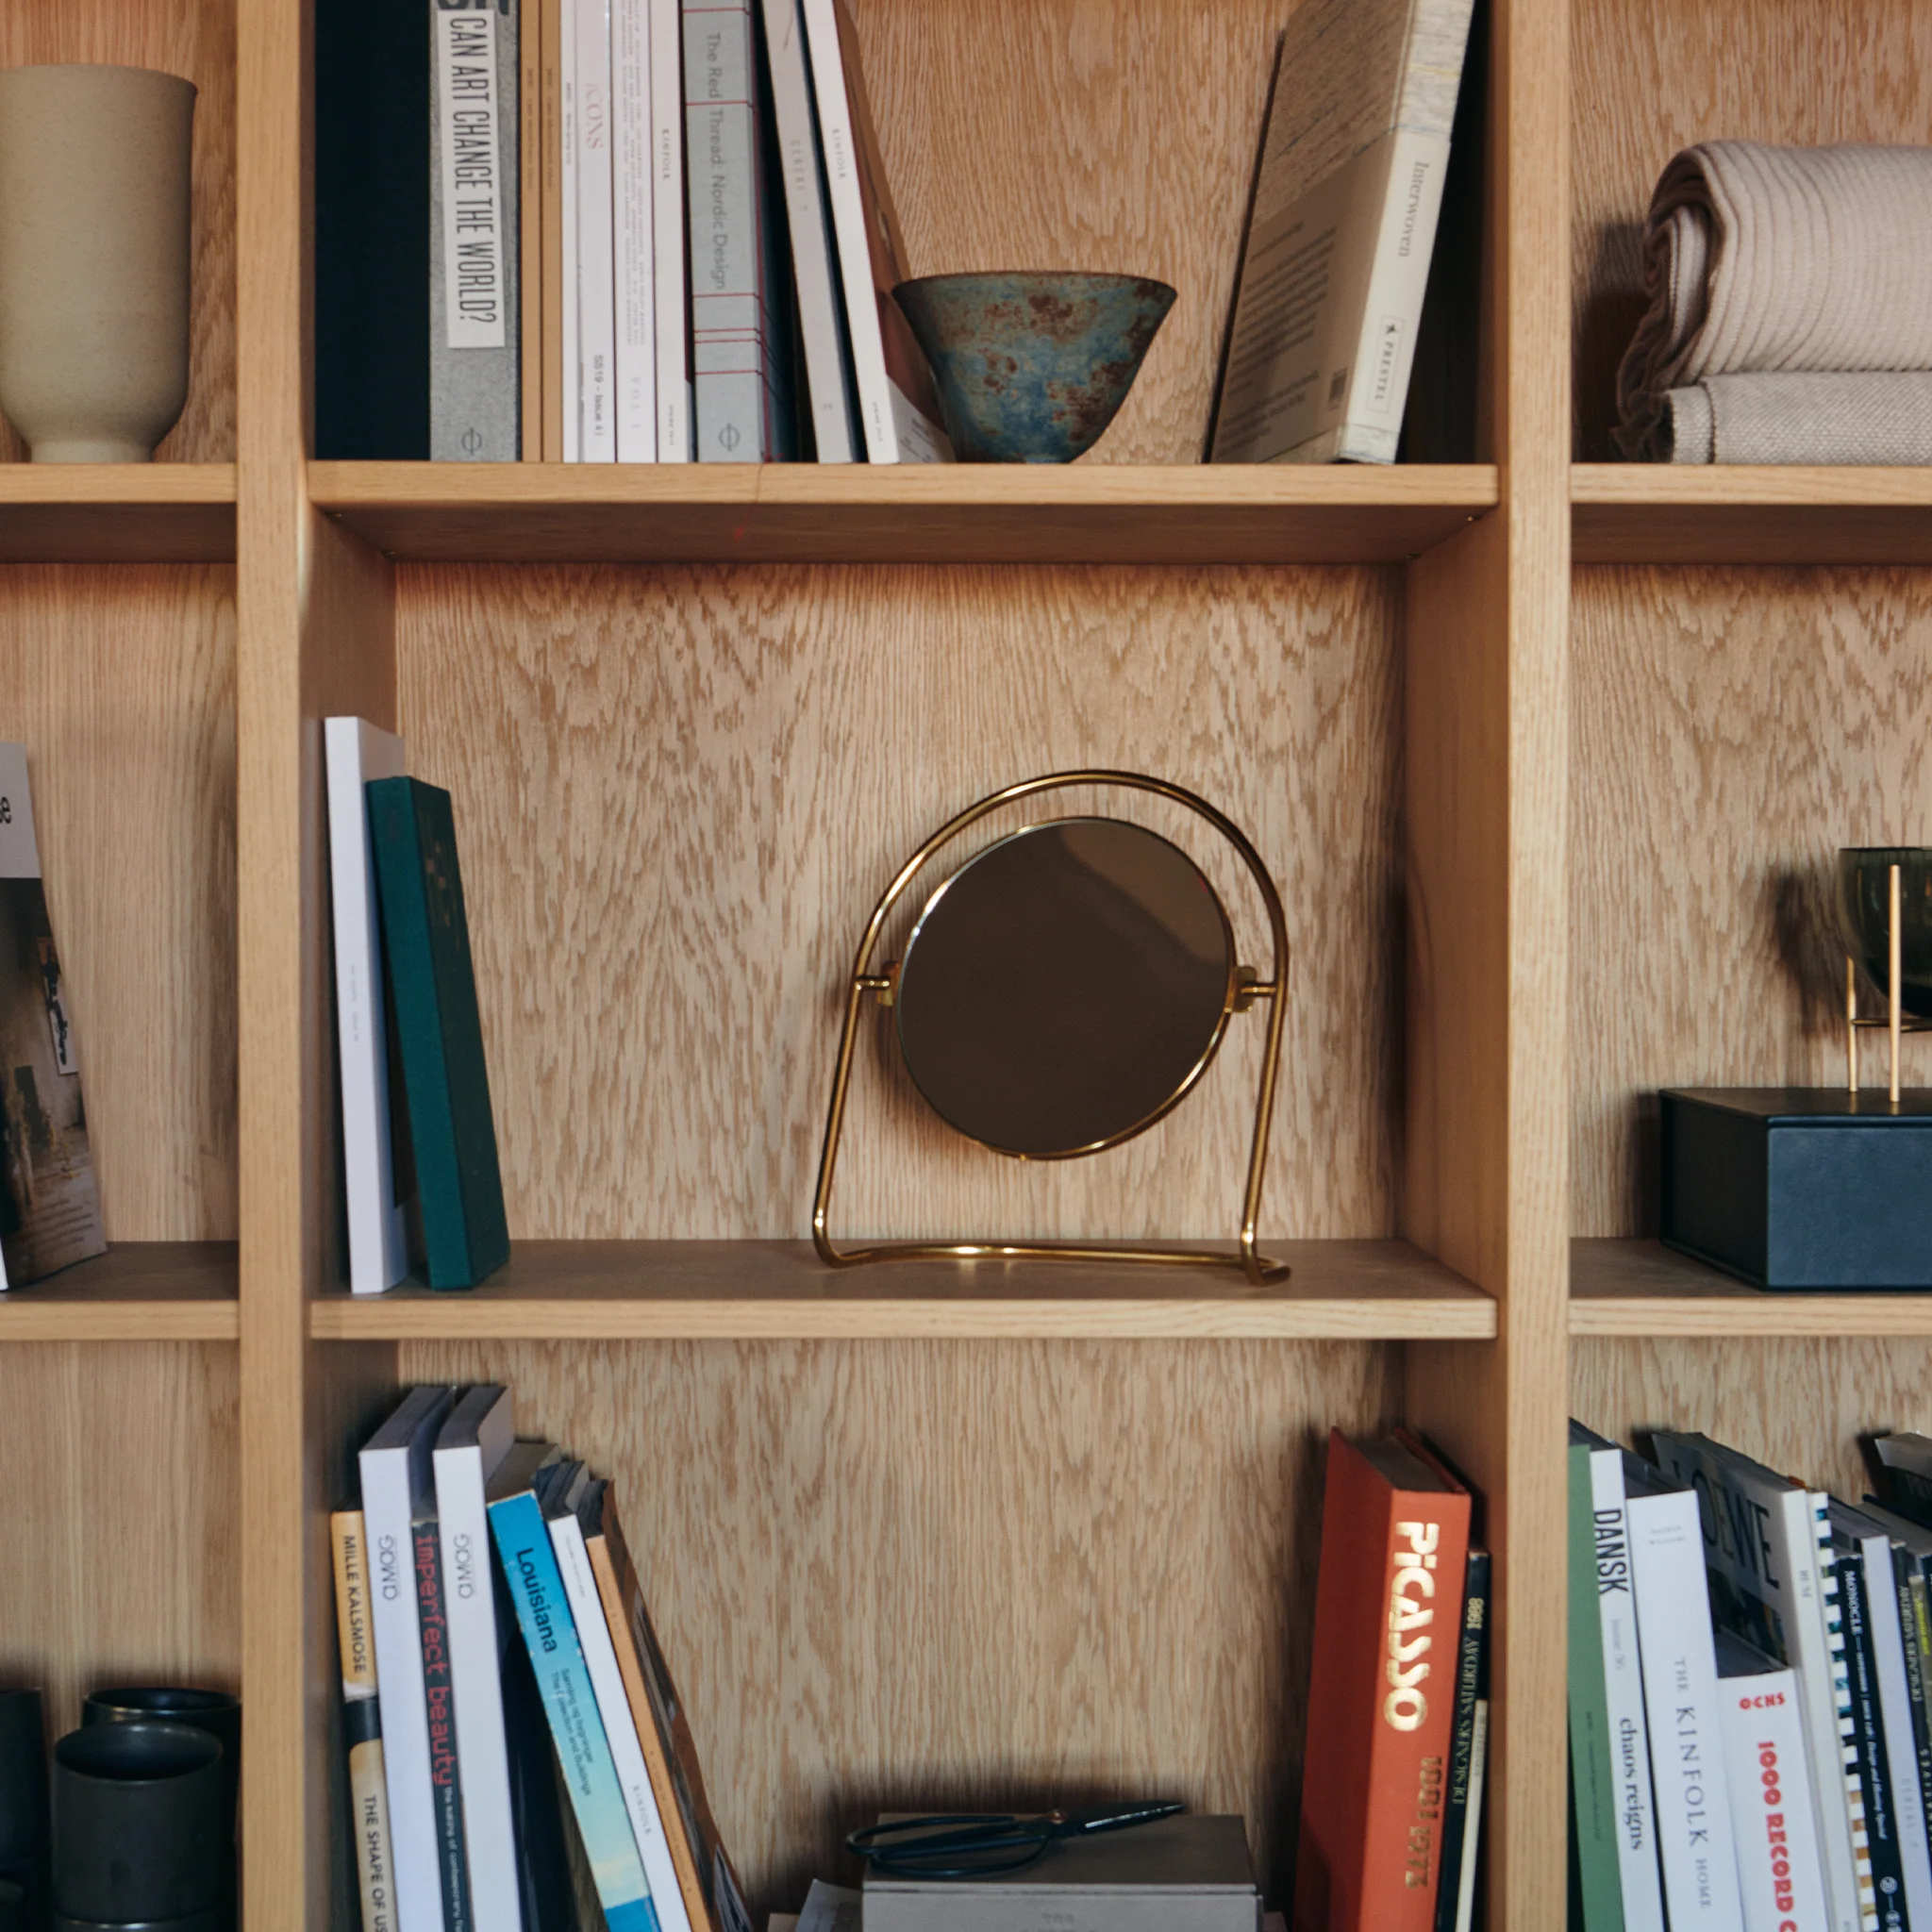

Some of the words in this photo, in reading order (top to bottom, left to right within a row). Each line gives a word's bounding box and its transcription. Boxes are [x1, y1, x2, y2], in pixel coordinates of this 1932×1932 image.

[450, 18, 488, 58] CAN
[708, 33, 721, 62] The
[453, 65, 490, 102] ART
[708, 67, 722, 98] Red
[454, 110, 492, 190] CHANGE
[662, 128, 671, 181] KINFOLK
[708, 109, 724, 170] Thread:
[832, 128, 846, 179] KINFOLK
[456, 197, 493, 234] THE
[711, 175, 725, 229] Nordic
[1398, 160, 1429, 258] Interwoven
[458, 242, 496, 325] WORLD?
[711, 235, 726, 290] Design
[1374, 341, 1394, 402] PRESTEL
[594, 394, 604, 422] Issue
[343, 1535, 359, 1580] MILLE
[1594, 1508, 1629, 1594] DANSK
[349, 1587, 367, 1674] KALSMOSE
[416, 1535, 448, 1675] imperfect
[515, 1547, 558, 1654] Louisiana
[1844, 1571, 1863, 1636] MONOCLE
[1460, 1636, 1479, 1715] SATURDAY
[1674, 1657, 1690, 1693] THE
[428, 1687, 457, 1785] beauty
[550, 1673, 562, 1690] The
[568, 1735, 581, 1754] and
[1619, 1717, 1638, 1779] chaos
[1675, 1706, 1708, 1848] KINFOLK
[1757, 1741, 1782, 1806] 1000
[364, 1796, 378, 1825] THE
[1418, 1756, 1443, 1820] 1881
[1624, 1783, 1644, 1851] reigns
[368, 1830, 383, 1884] SHAPE
[1405, 1825, 1431, 1890] 1973
[1695, 1858, 1712, 1909] HOME
[1766, 1813, 1794, 1913] RECORD
[373, 1889, 387, 1911] OF
